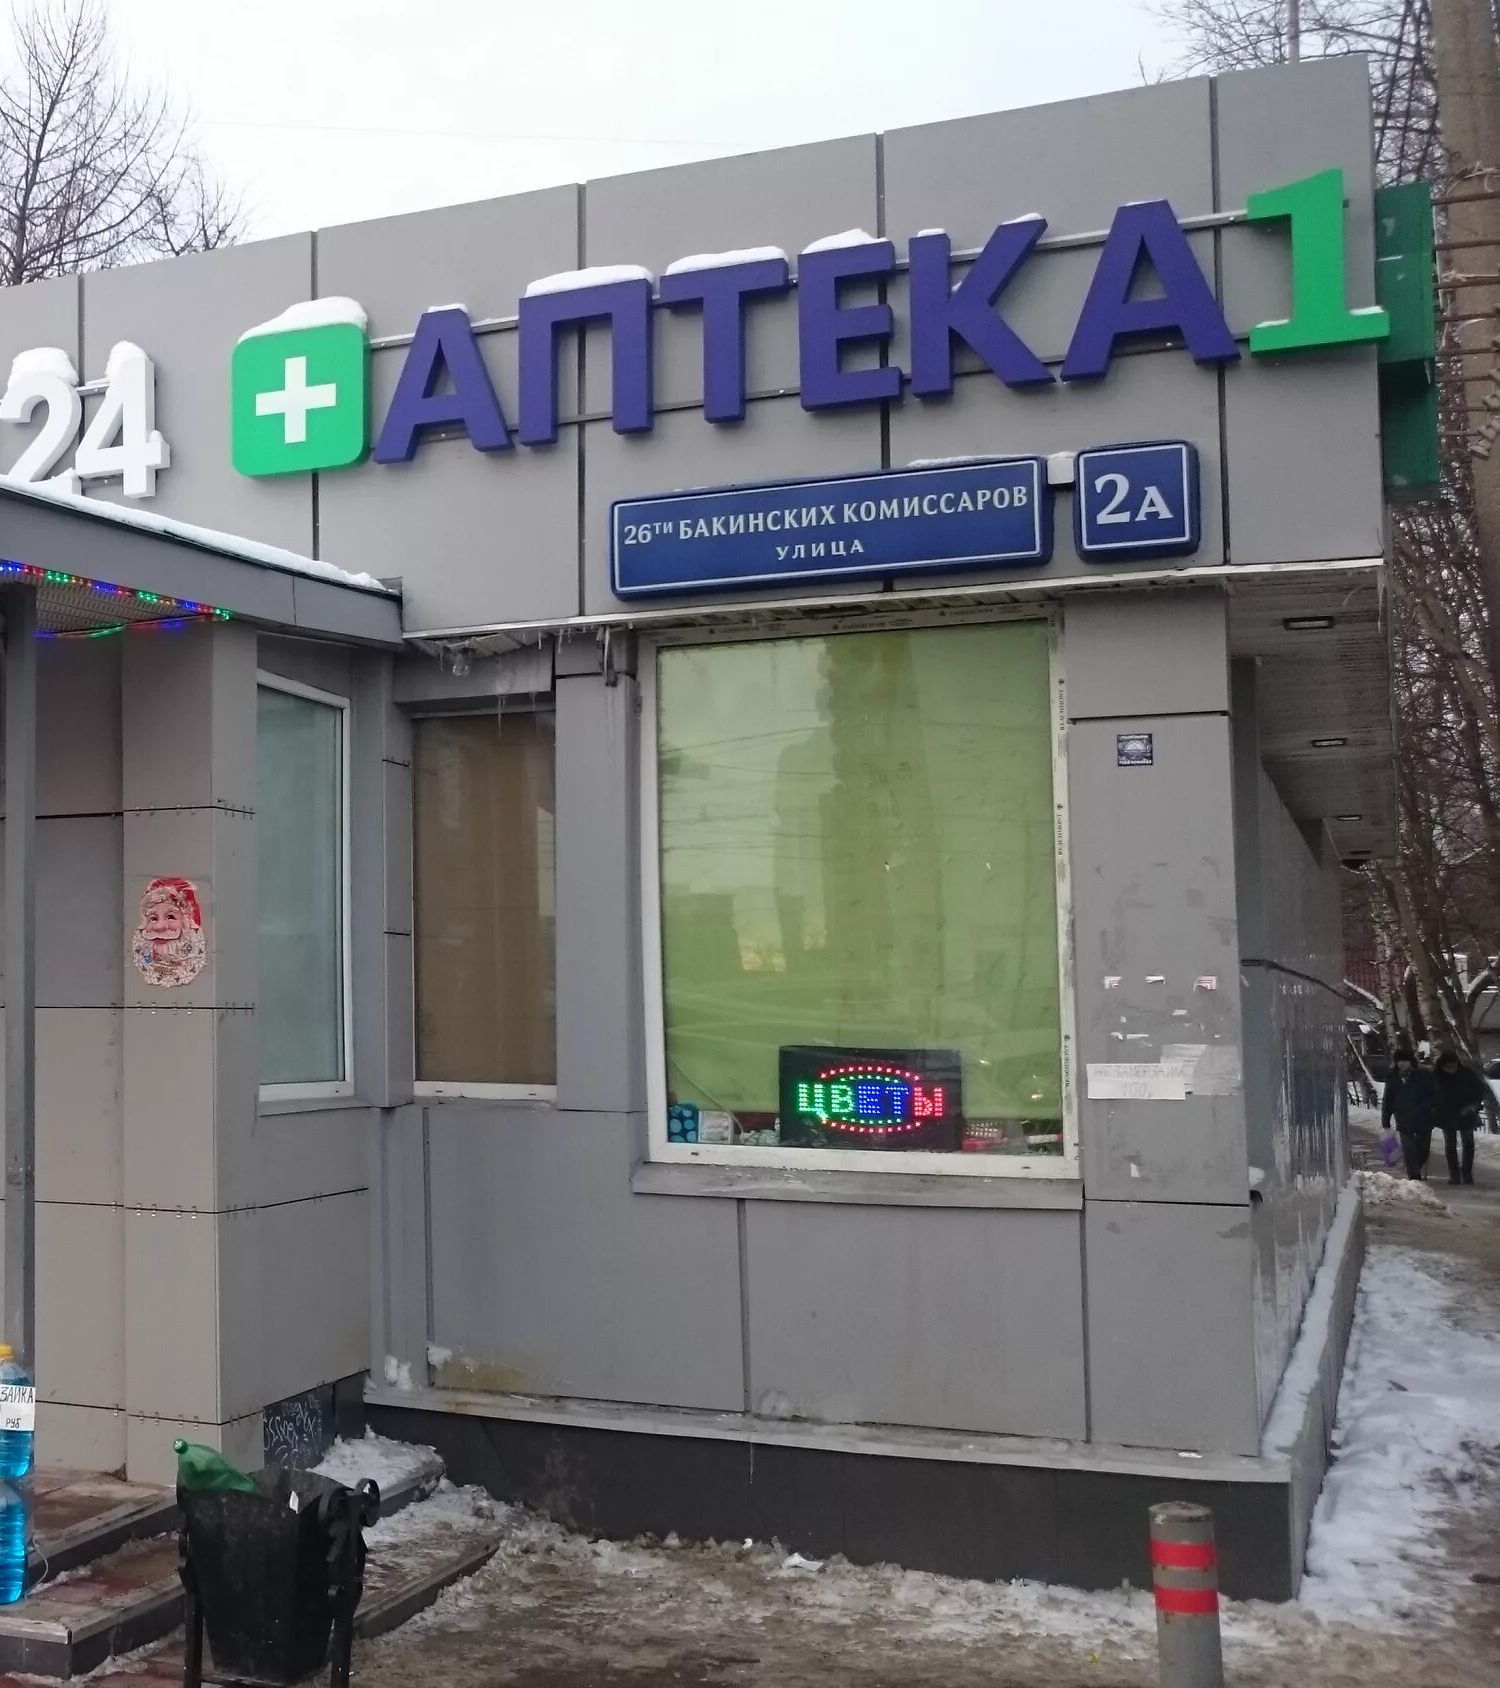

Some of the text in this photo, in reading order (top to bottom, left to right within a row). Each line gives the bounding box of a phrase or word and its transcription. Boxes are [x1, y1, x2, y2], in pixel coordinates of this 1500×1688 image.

[679, 504, 835, 540] БАКИНСКИХ
[843, 485, 1028, 524] КОМИССАРОВ
[1094, 473, 1175, 525] 2А
[776, 539, 864, 561] УЛИЦА
[798, 1083, 943, 1120] ЦВЕТЫ
